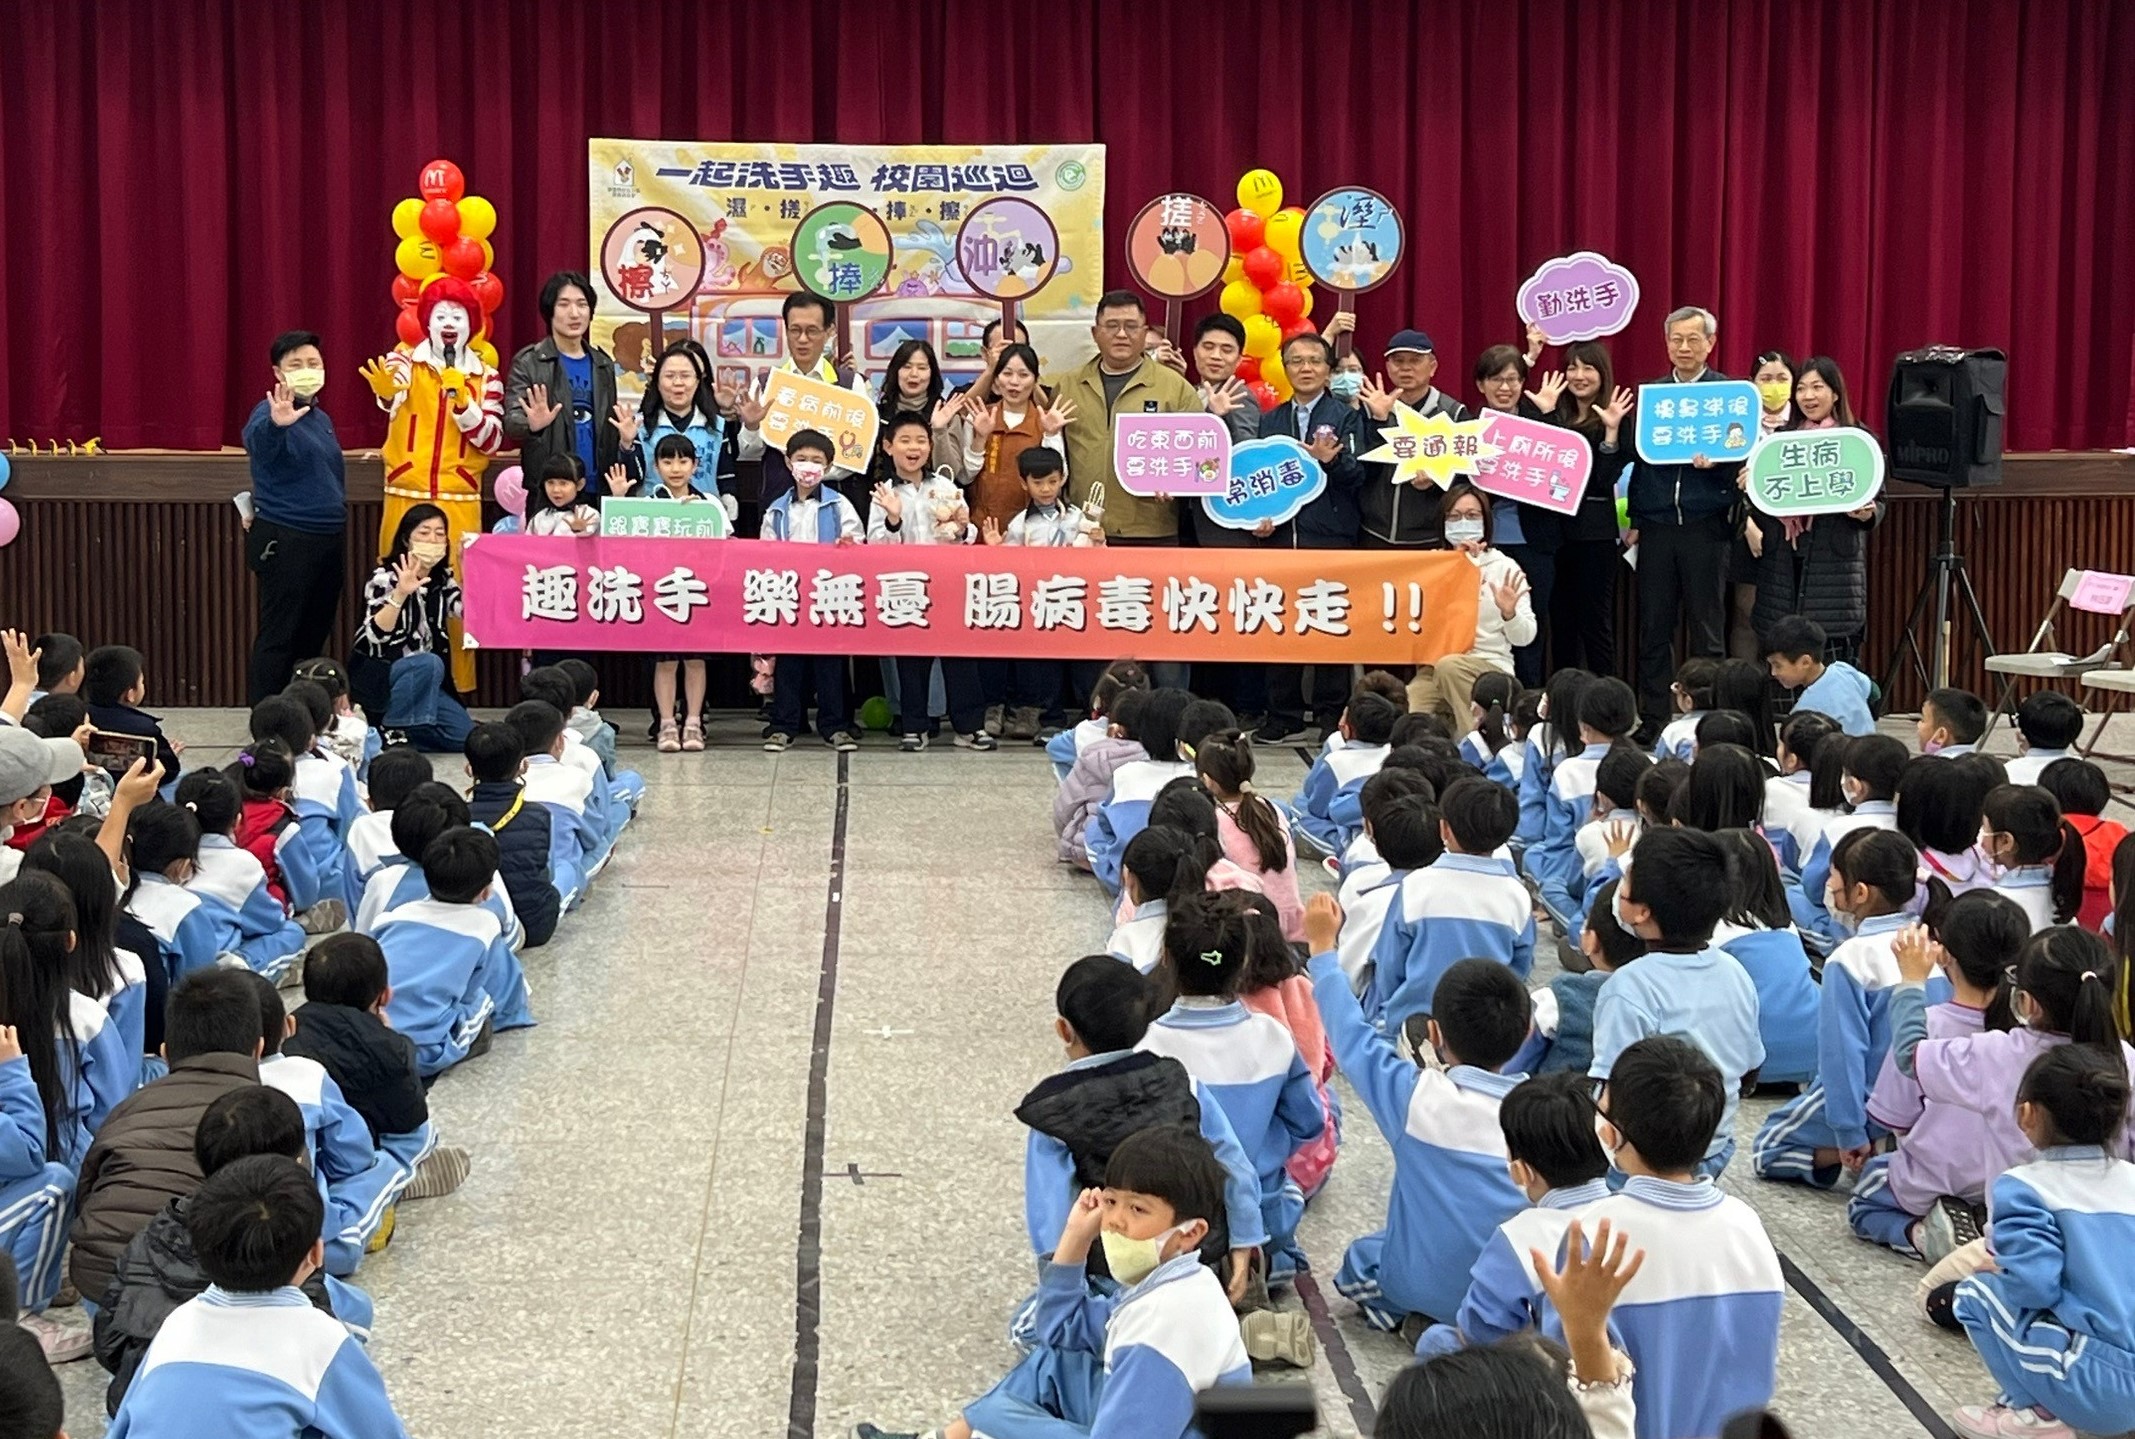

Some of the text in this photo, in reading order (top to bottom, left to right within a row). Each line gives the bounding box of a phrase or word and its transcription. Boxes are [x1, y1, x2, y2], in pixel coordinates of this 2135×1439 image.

[656, 160, 1040, 193] 一起洗手趣 校園巡迴
[828, 262, 862, 294] 捧
[1537, 281, 1620, 318] 勤洗手
[1127, 428, 1218, 450] 吃東西前
[1393, 434, 1479, 459] 要通報
[1652, 423, 1723, 446] 要洗手
[1126, 456, 1193, 477] 要洗手
[1781, 439, 1841, 470] 生病
[1226, 460, 1305, 506] 常消毒
[1764, 470, 1856, 501] 不上學
[521, 564, 709, 623] 趣洗手
[743, 568, 931, 628] 樂無憂
[964, 571, 1351, 635] 腸病毒快快走
